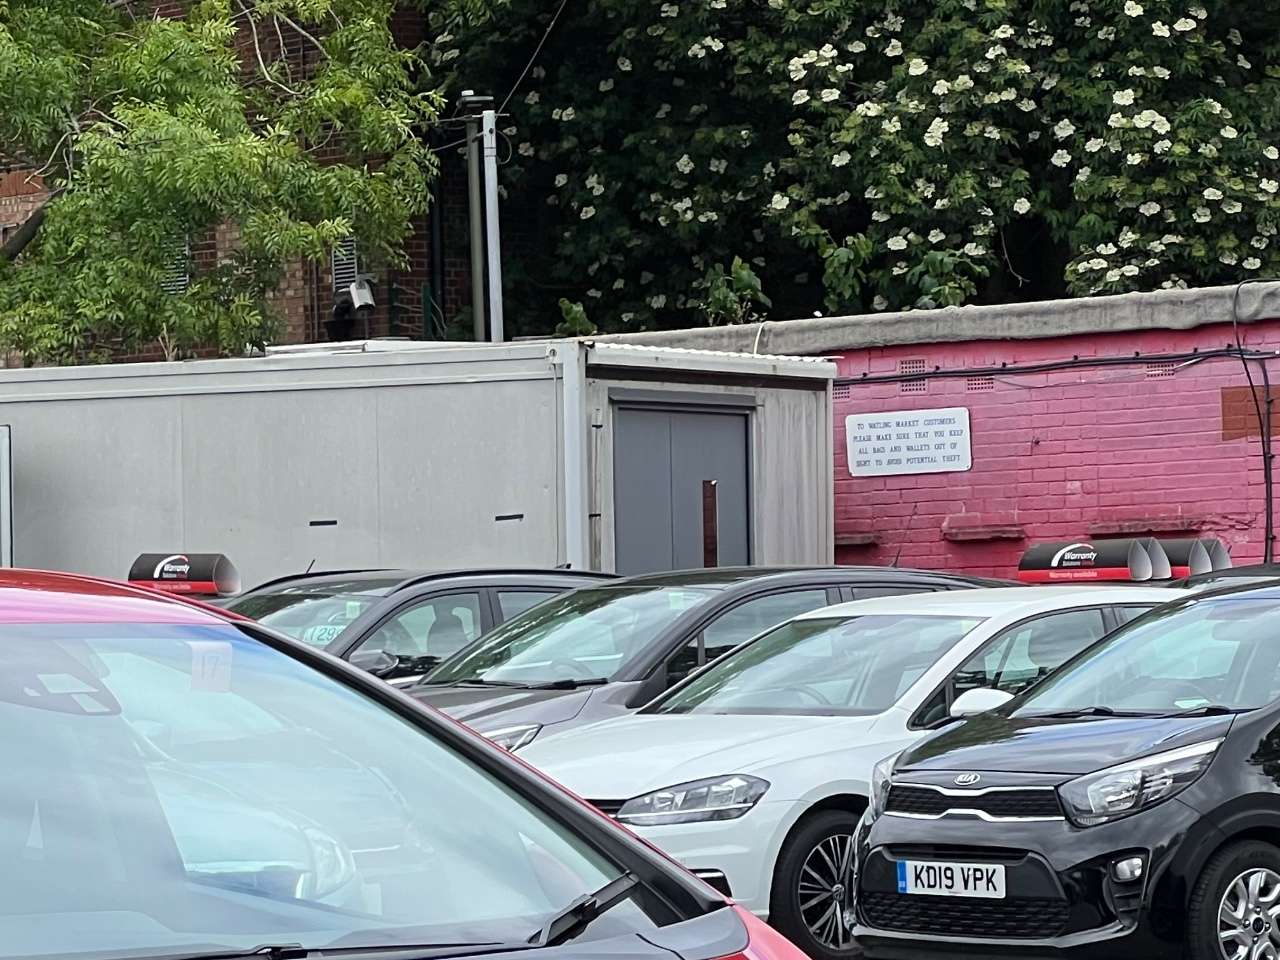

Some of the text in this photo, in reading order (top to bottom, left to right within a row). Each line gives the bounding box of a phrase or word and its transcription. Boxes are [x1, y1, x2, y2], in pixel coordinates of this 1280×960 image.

[853, 434, 871, 442] PLEASE
[906, 456, 936, 464] POTENTIAL
[942, 454, 960, 462] THEFT
[1064, 551, 1097, 561] Warranty
[957, 773, 977, 782] KIA
[914, 865, 997, 891] KD19 VPK
